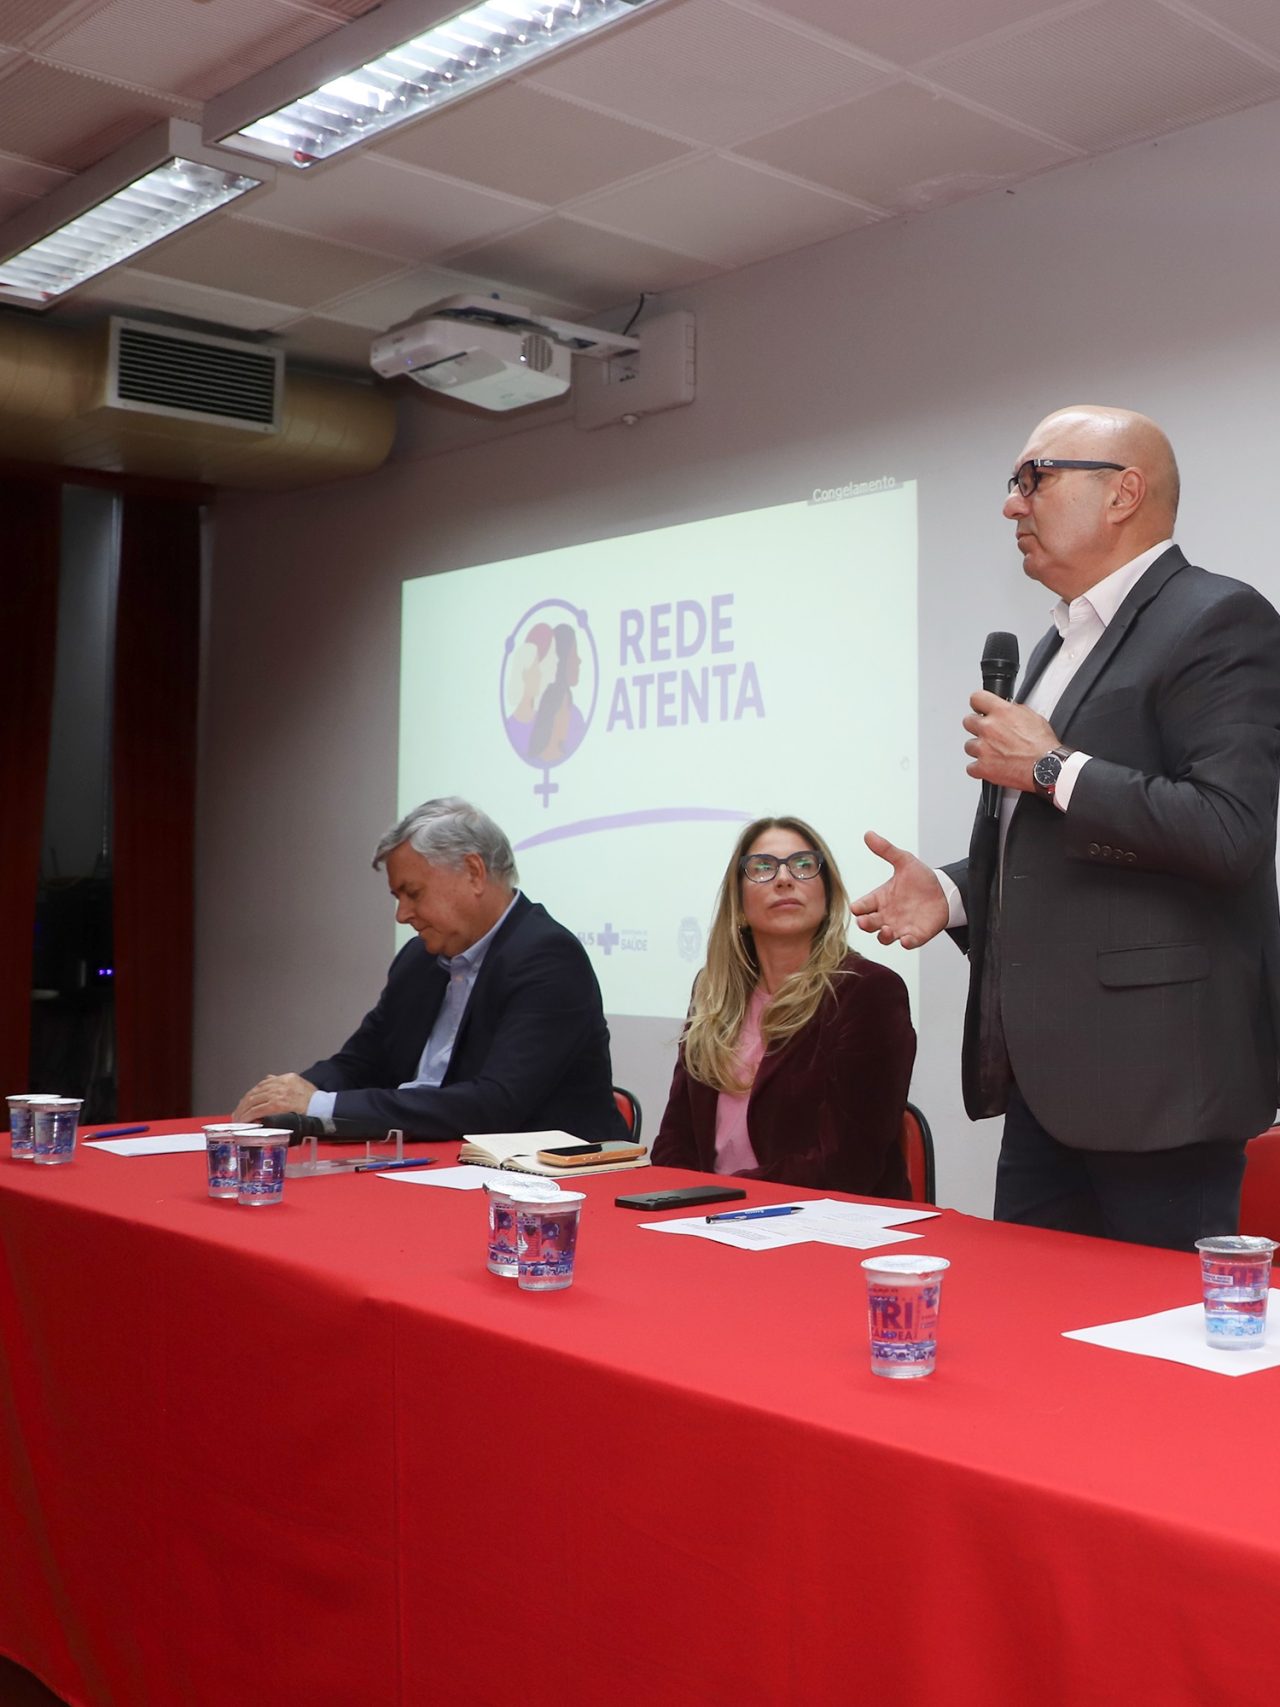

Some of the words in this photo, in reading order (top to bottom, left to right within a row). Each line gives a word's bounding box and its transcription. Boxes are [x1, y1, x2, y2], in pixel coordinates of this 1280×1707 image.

[812, 476, 896, 503] Congelamento
[620, 593, 734, 666] REDE
[606, 661, 766, 732] ATENTA
